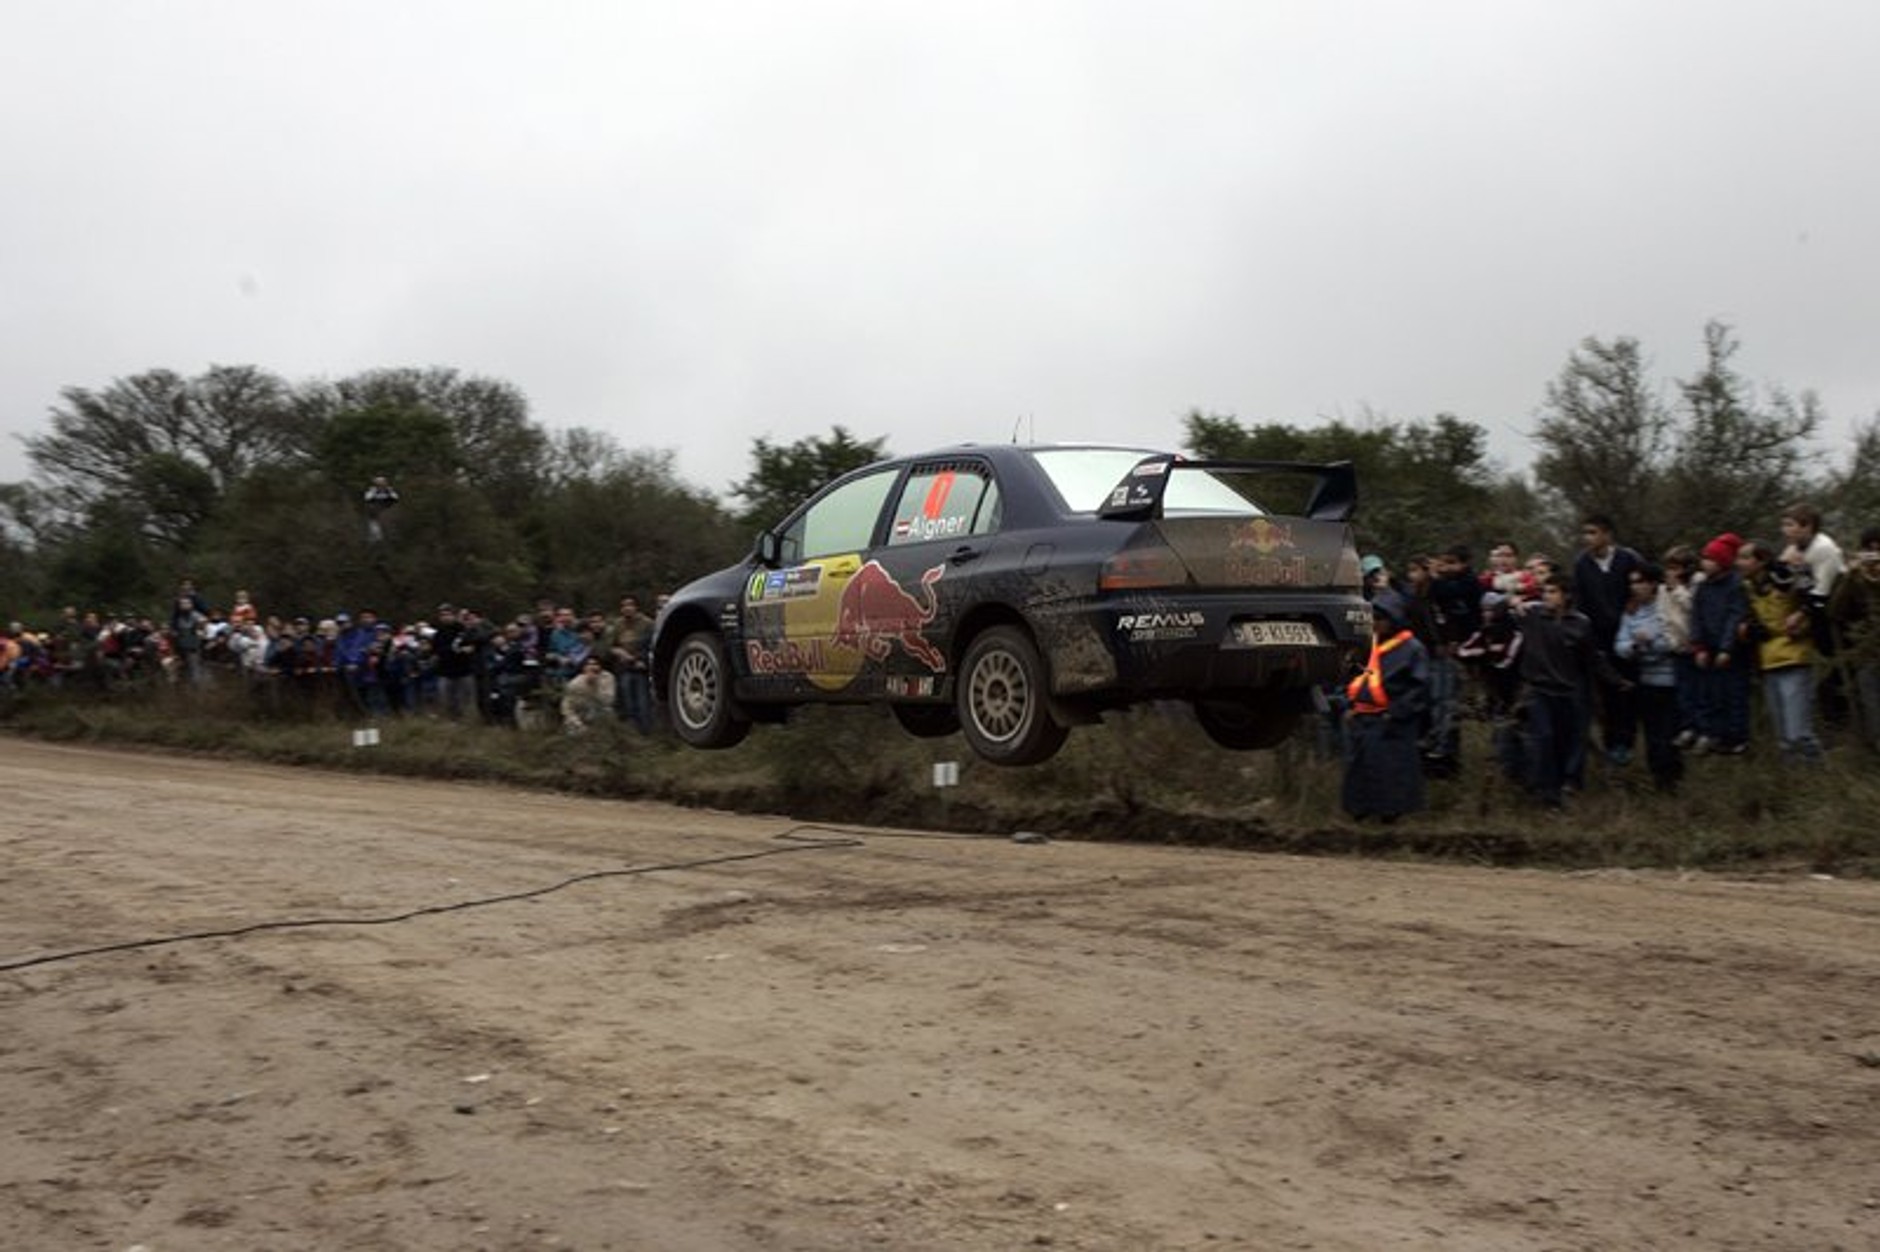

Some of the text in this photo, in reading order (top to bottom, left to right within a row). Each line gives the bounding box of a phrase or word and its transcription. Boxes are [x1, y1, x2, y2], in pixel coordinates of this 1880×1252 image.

[907, 515, 966, 540] Aigner
[1116, 611, 1205, 630] REMUS
[747, 640, 827, 674] Red Bull
